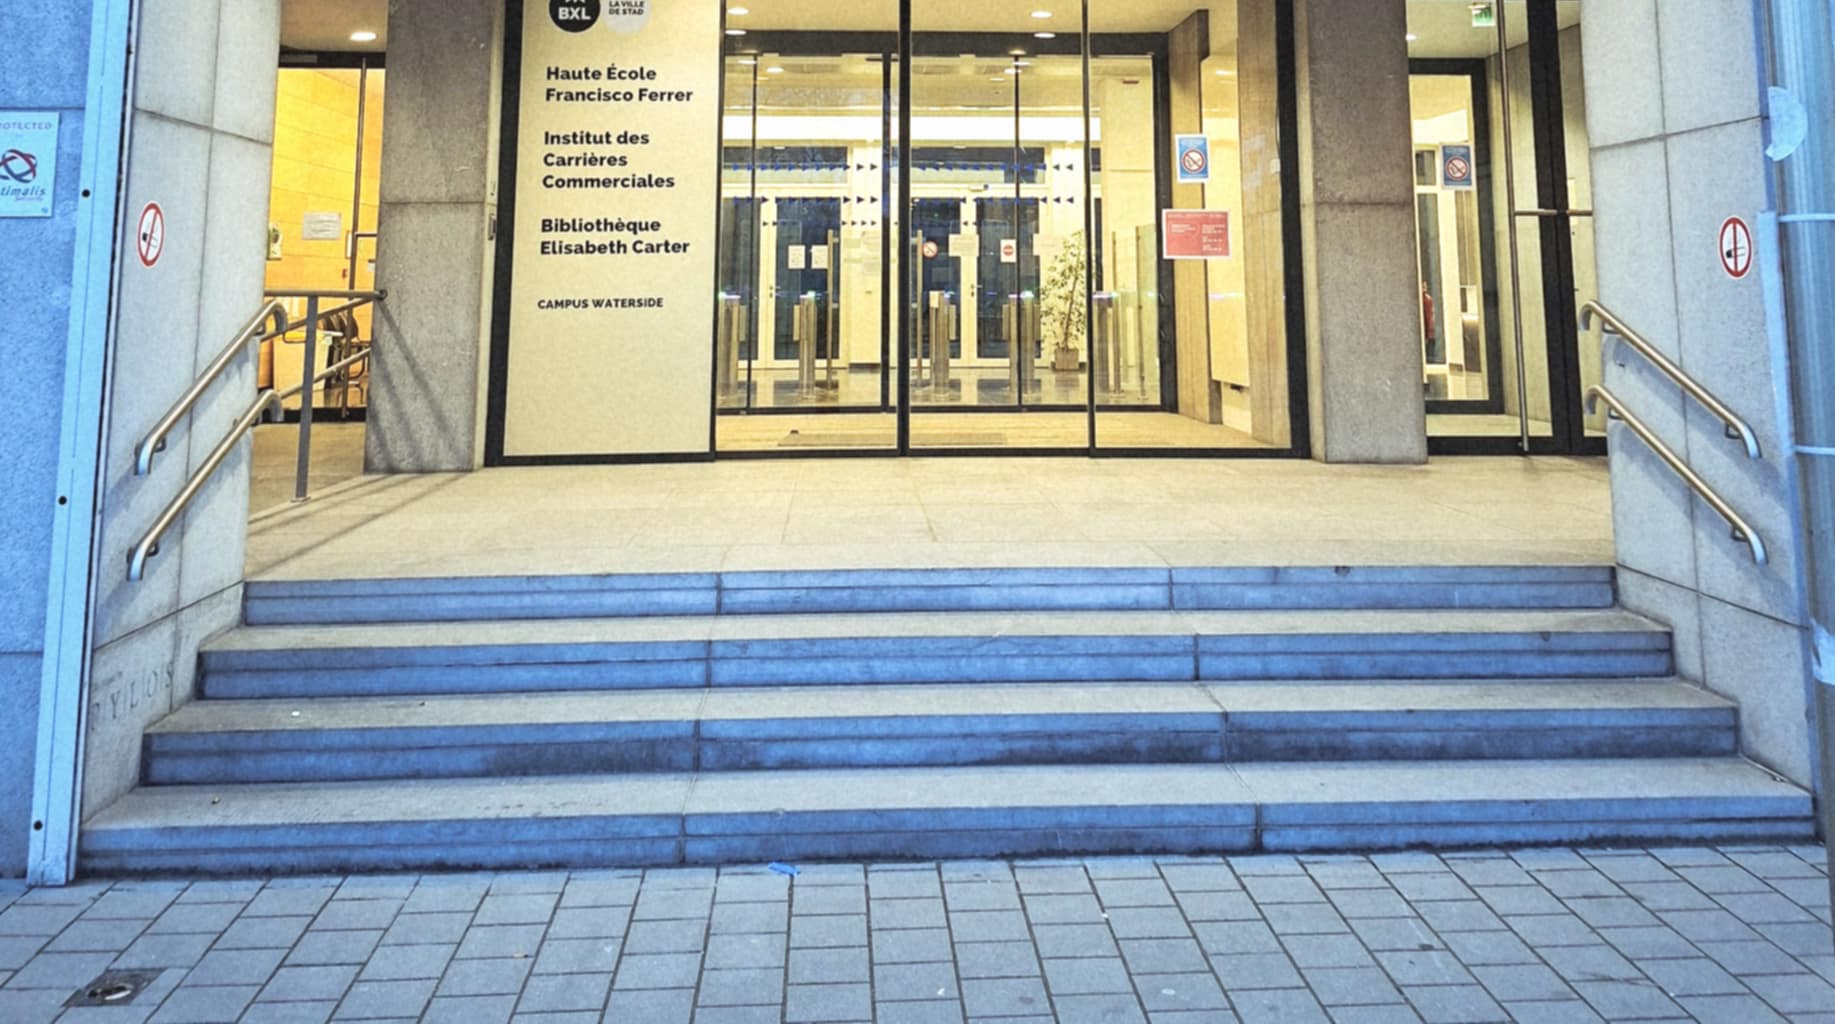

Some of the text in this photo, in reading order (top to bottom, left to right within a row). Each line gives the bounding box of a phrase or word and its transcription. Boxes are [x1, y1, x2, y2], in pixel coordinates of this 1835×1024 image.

[608, 0, 645, 9] LA VILLE
[608, 8, 644, 16] DE STAD
[558, 6, 591, 21] BXL
[546, 63, 657, 81] Haute École
[545, 87, 693, 102] Francisco Ferrer
[544, 130, 650, 145] Institut des
[543, 152, 628, 167] Carrières
[542, 173, 675, 189] Commerciales
[541, 217, 661, 235] Bibliothèque
[540, 239, 690, 255] Elisabeth Carter
[537, 297, 664, 310] CAMPUS WATERSIDE
